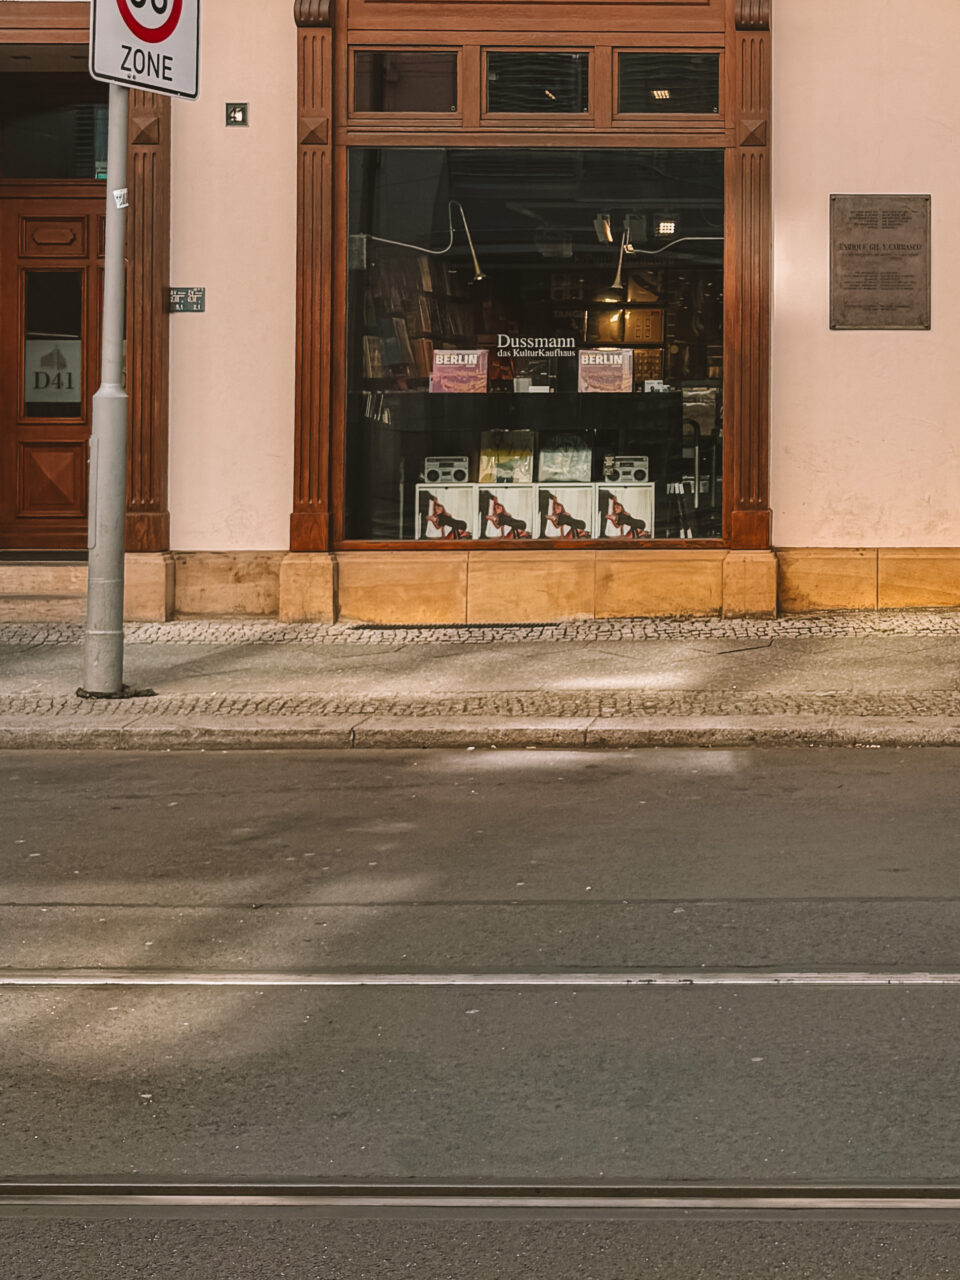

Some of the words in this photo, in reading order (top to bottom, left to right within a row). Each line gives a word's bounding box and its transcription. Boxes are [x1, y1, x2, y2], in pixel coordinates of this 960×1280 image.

[121, 45, 173, 81] ZONE
[497, 334, 576, 348] Dussmann
[435, 354, 478, 365] BERLIN
[497, 349, 511, 357] das
[513, 349, 576, 357] KulturKaufhaus
[581, 353, 623, 365] BERLIN
[32, 371, 75, 390] D41
